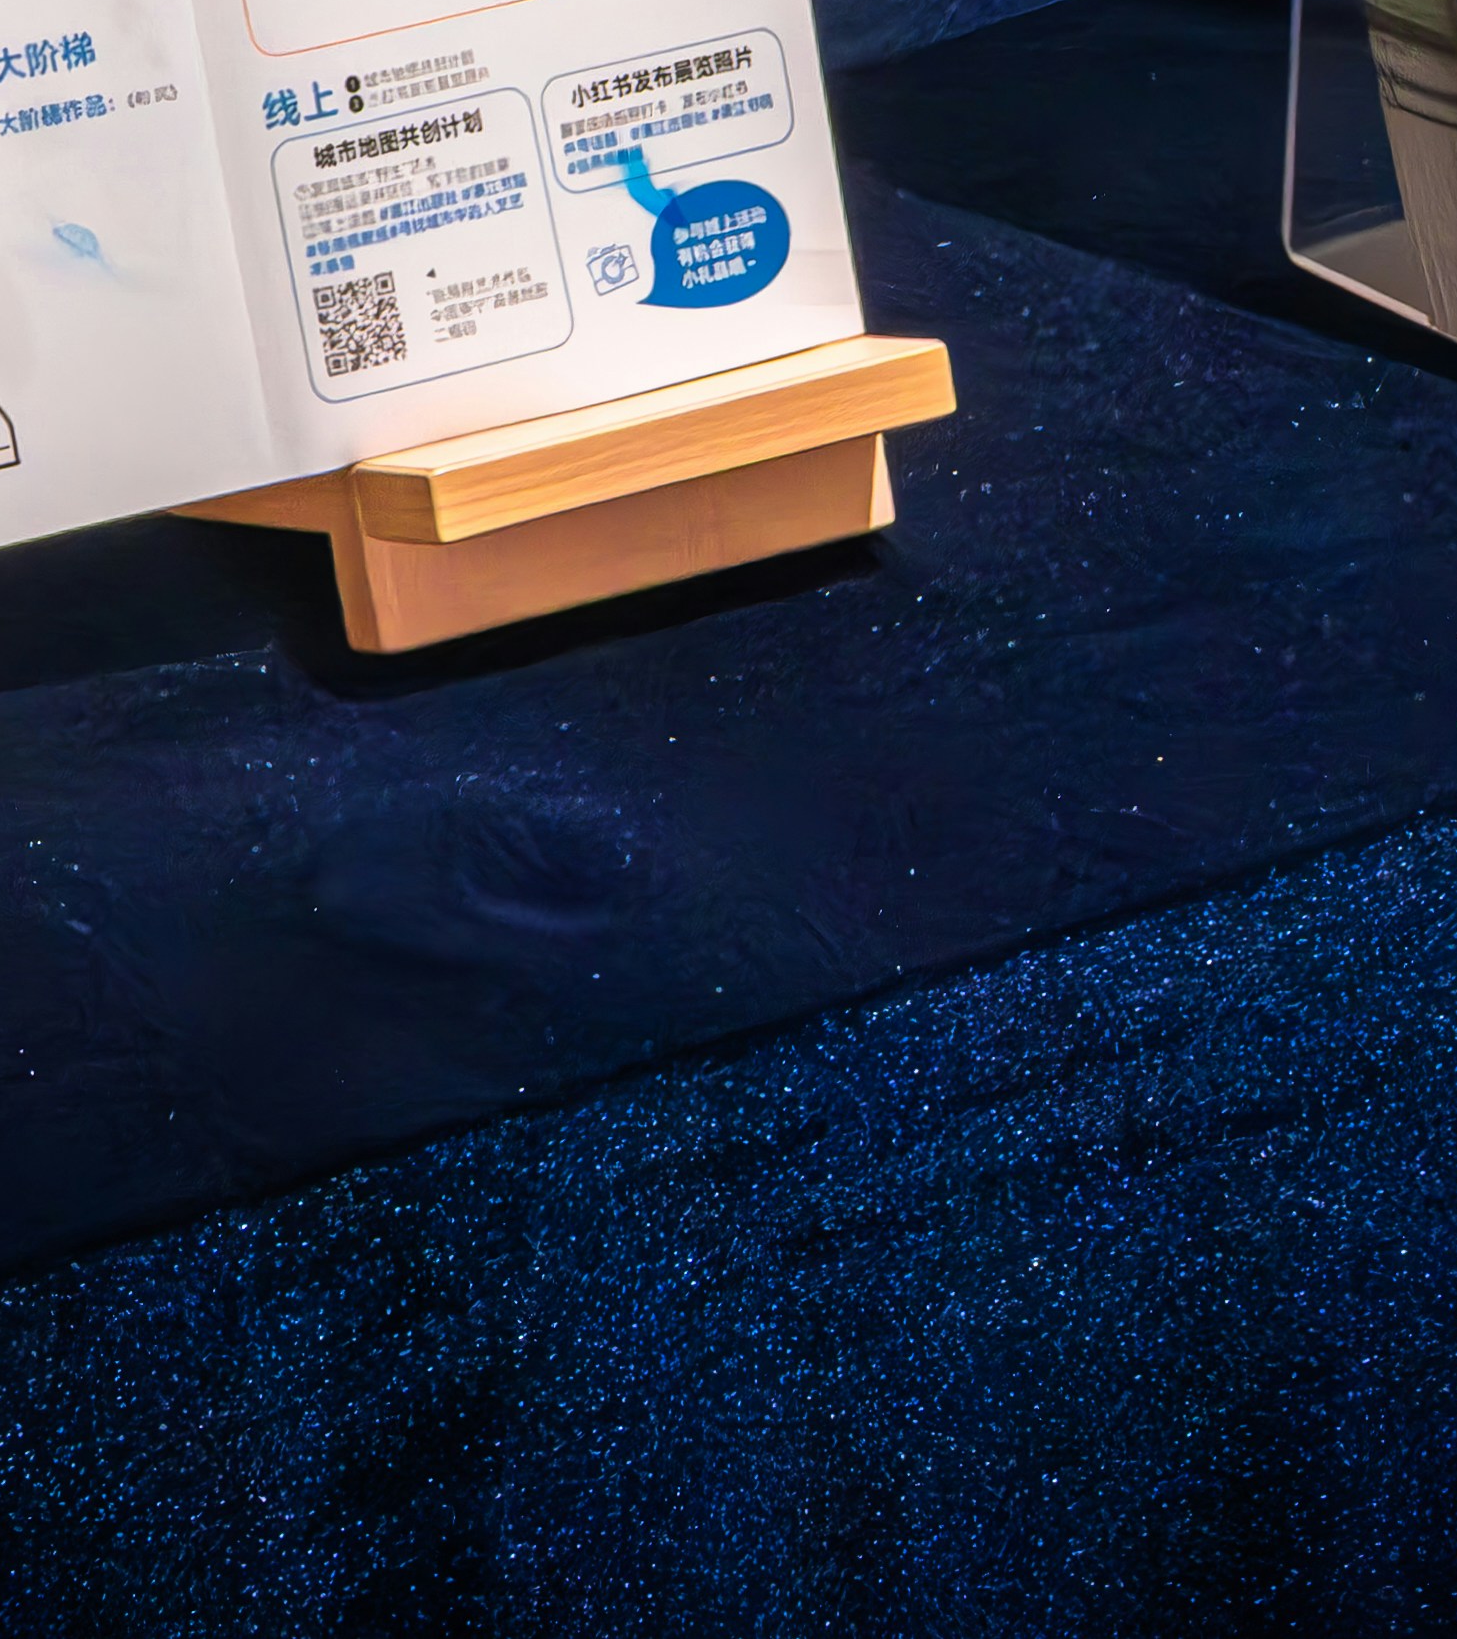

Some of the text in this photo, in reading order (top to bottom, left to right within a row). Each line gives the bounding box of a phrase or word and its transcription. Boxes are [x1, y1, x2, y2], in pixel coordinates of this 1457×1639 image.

[262, 80, 339, 130] 线上
[571, 45, 752, 109] 小红书发布展览照片
[313, 107, 484, 169] 城市地图共创计划
